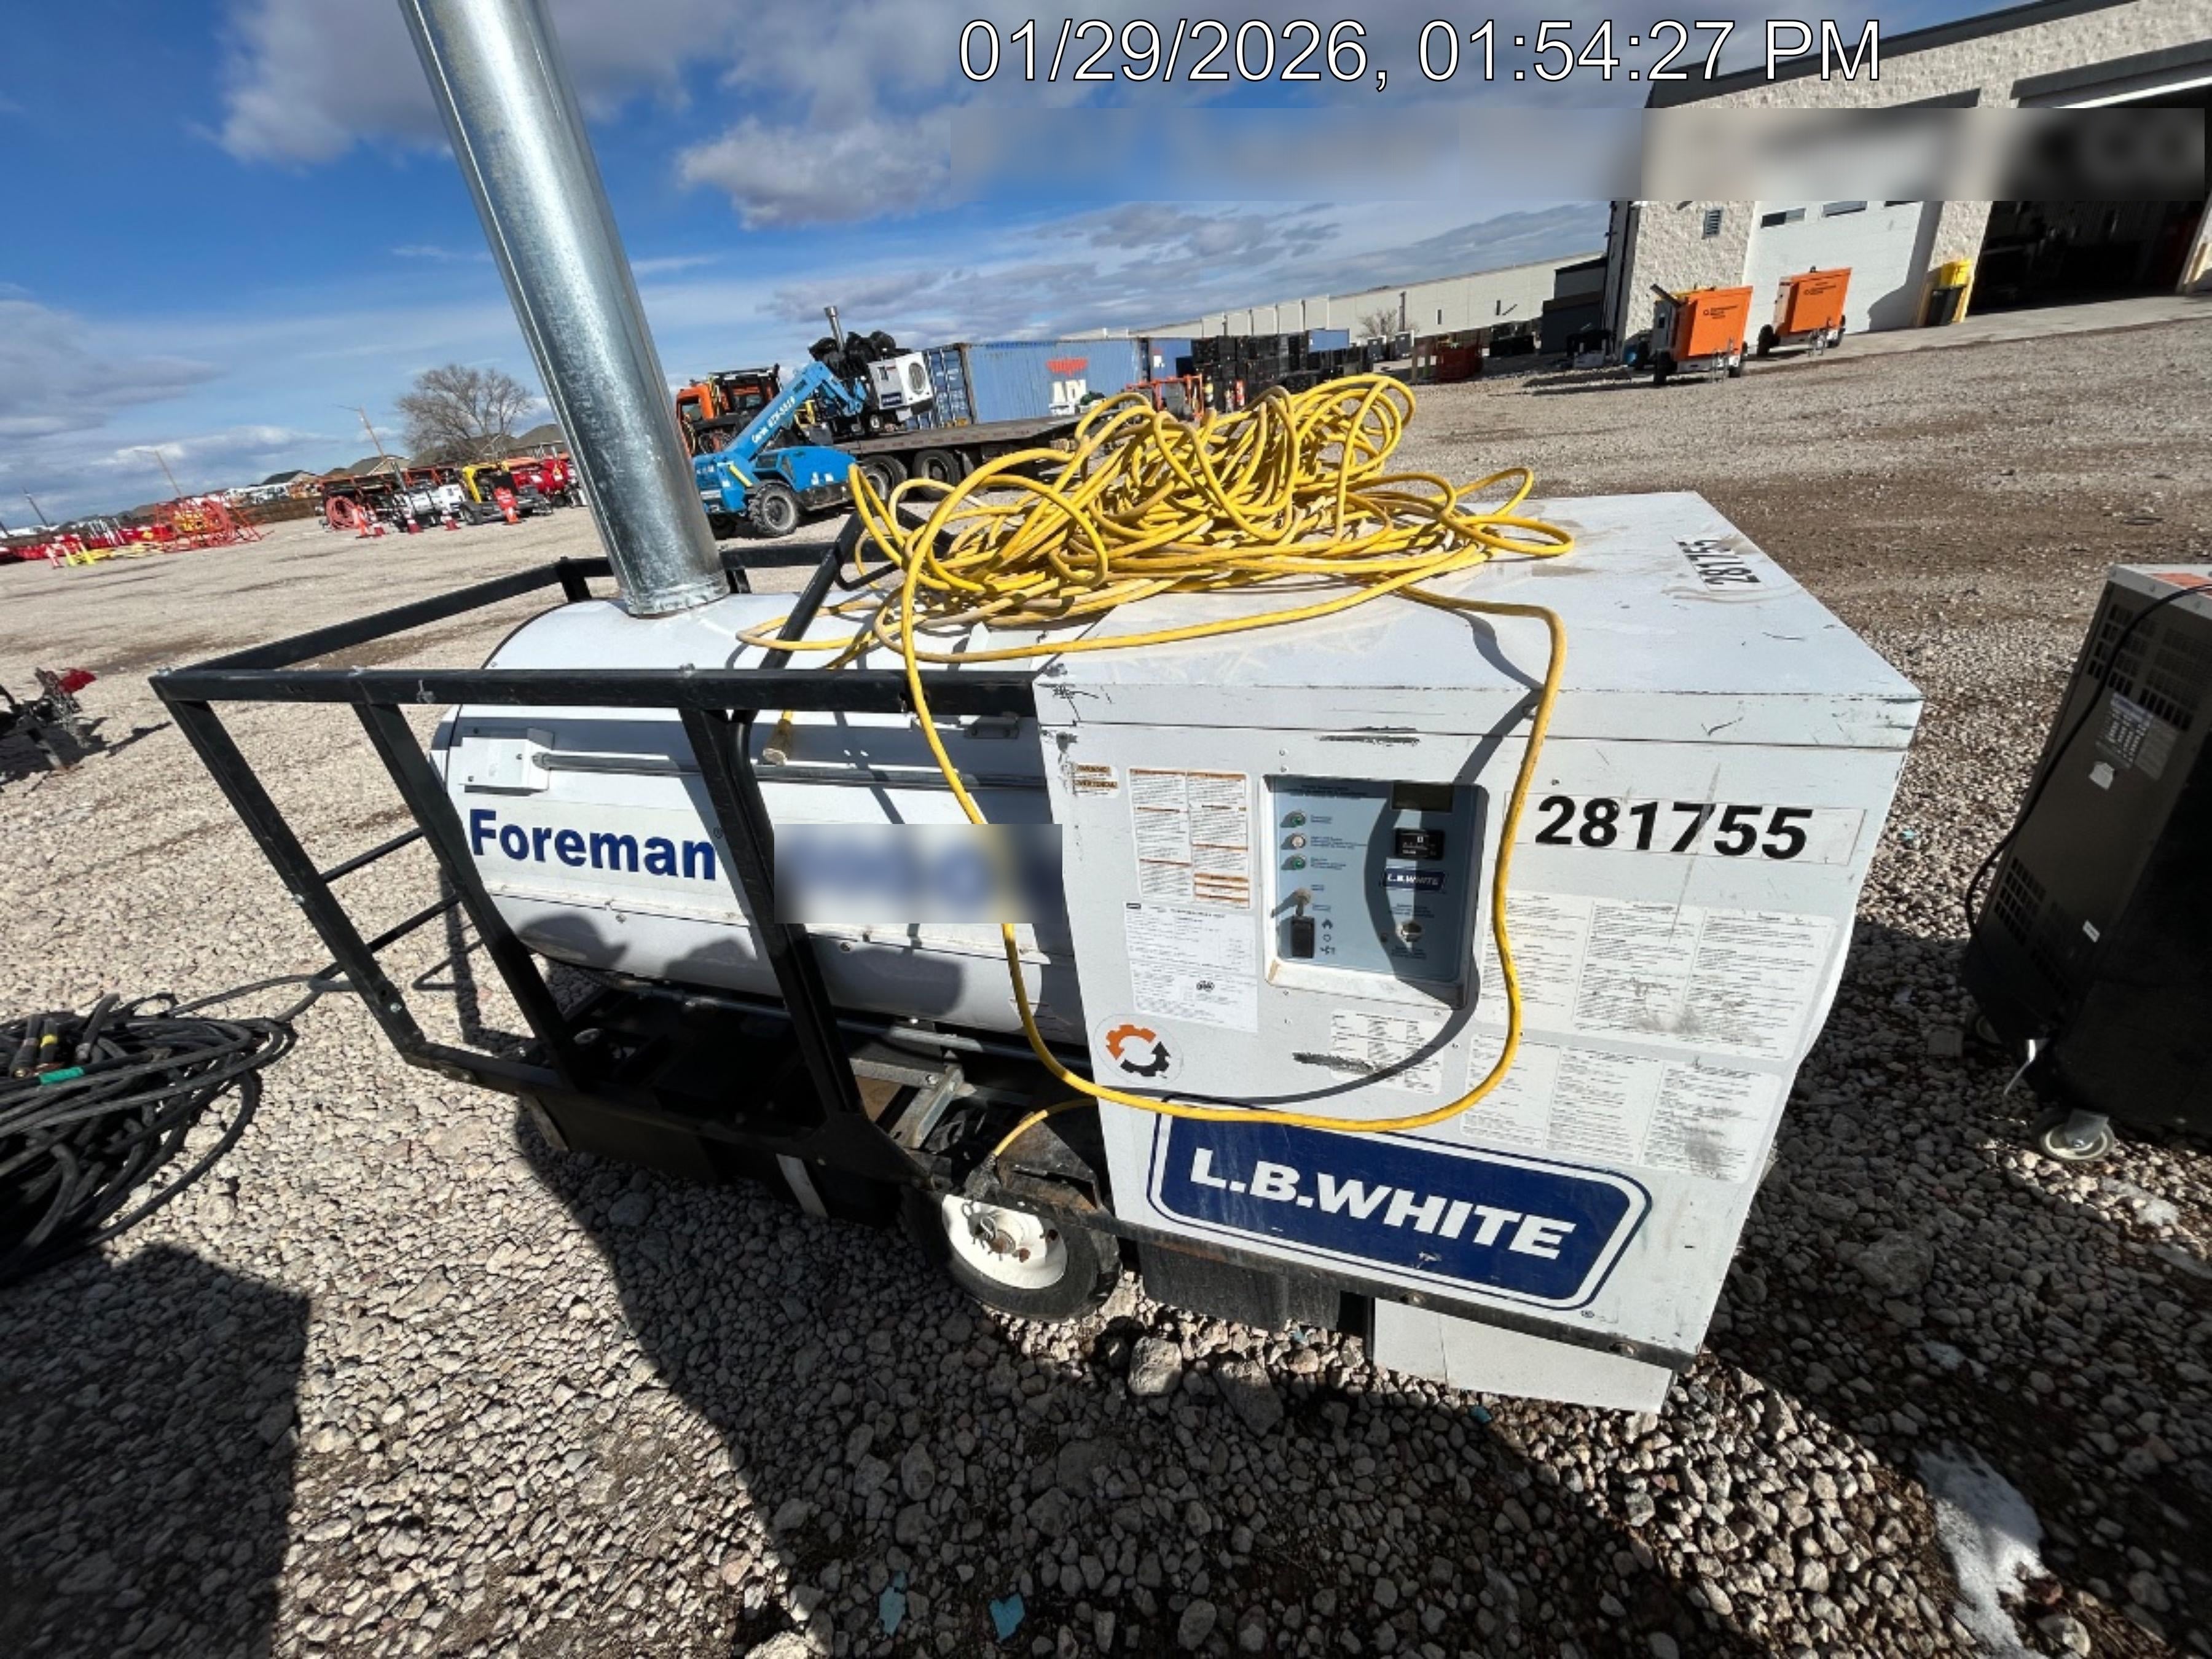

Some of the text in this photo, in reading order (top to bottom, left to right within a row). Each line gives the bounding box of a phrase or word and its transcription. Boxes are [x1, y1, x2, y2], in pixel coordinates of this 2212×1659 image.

[469, 808, 716, 880] Foreman
[1535, 794, 1813, 860] 281755
[1190, 1147, 1577, 1260] L.B.WHITE
